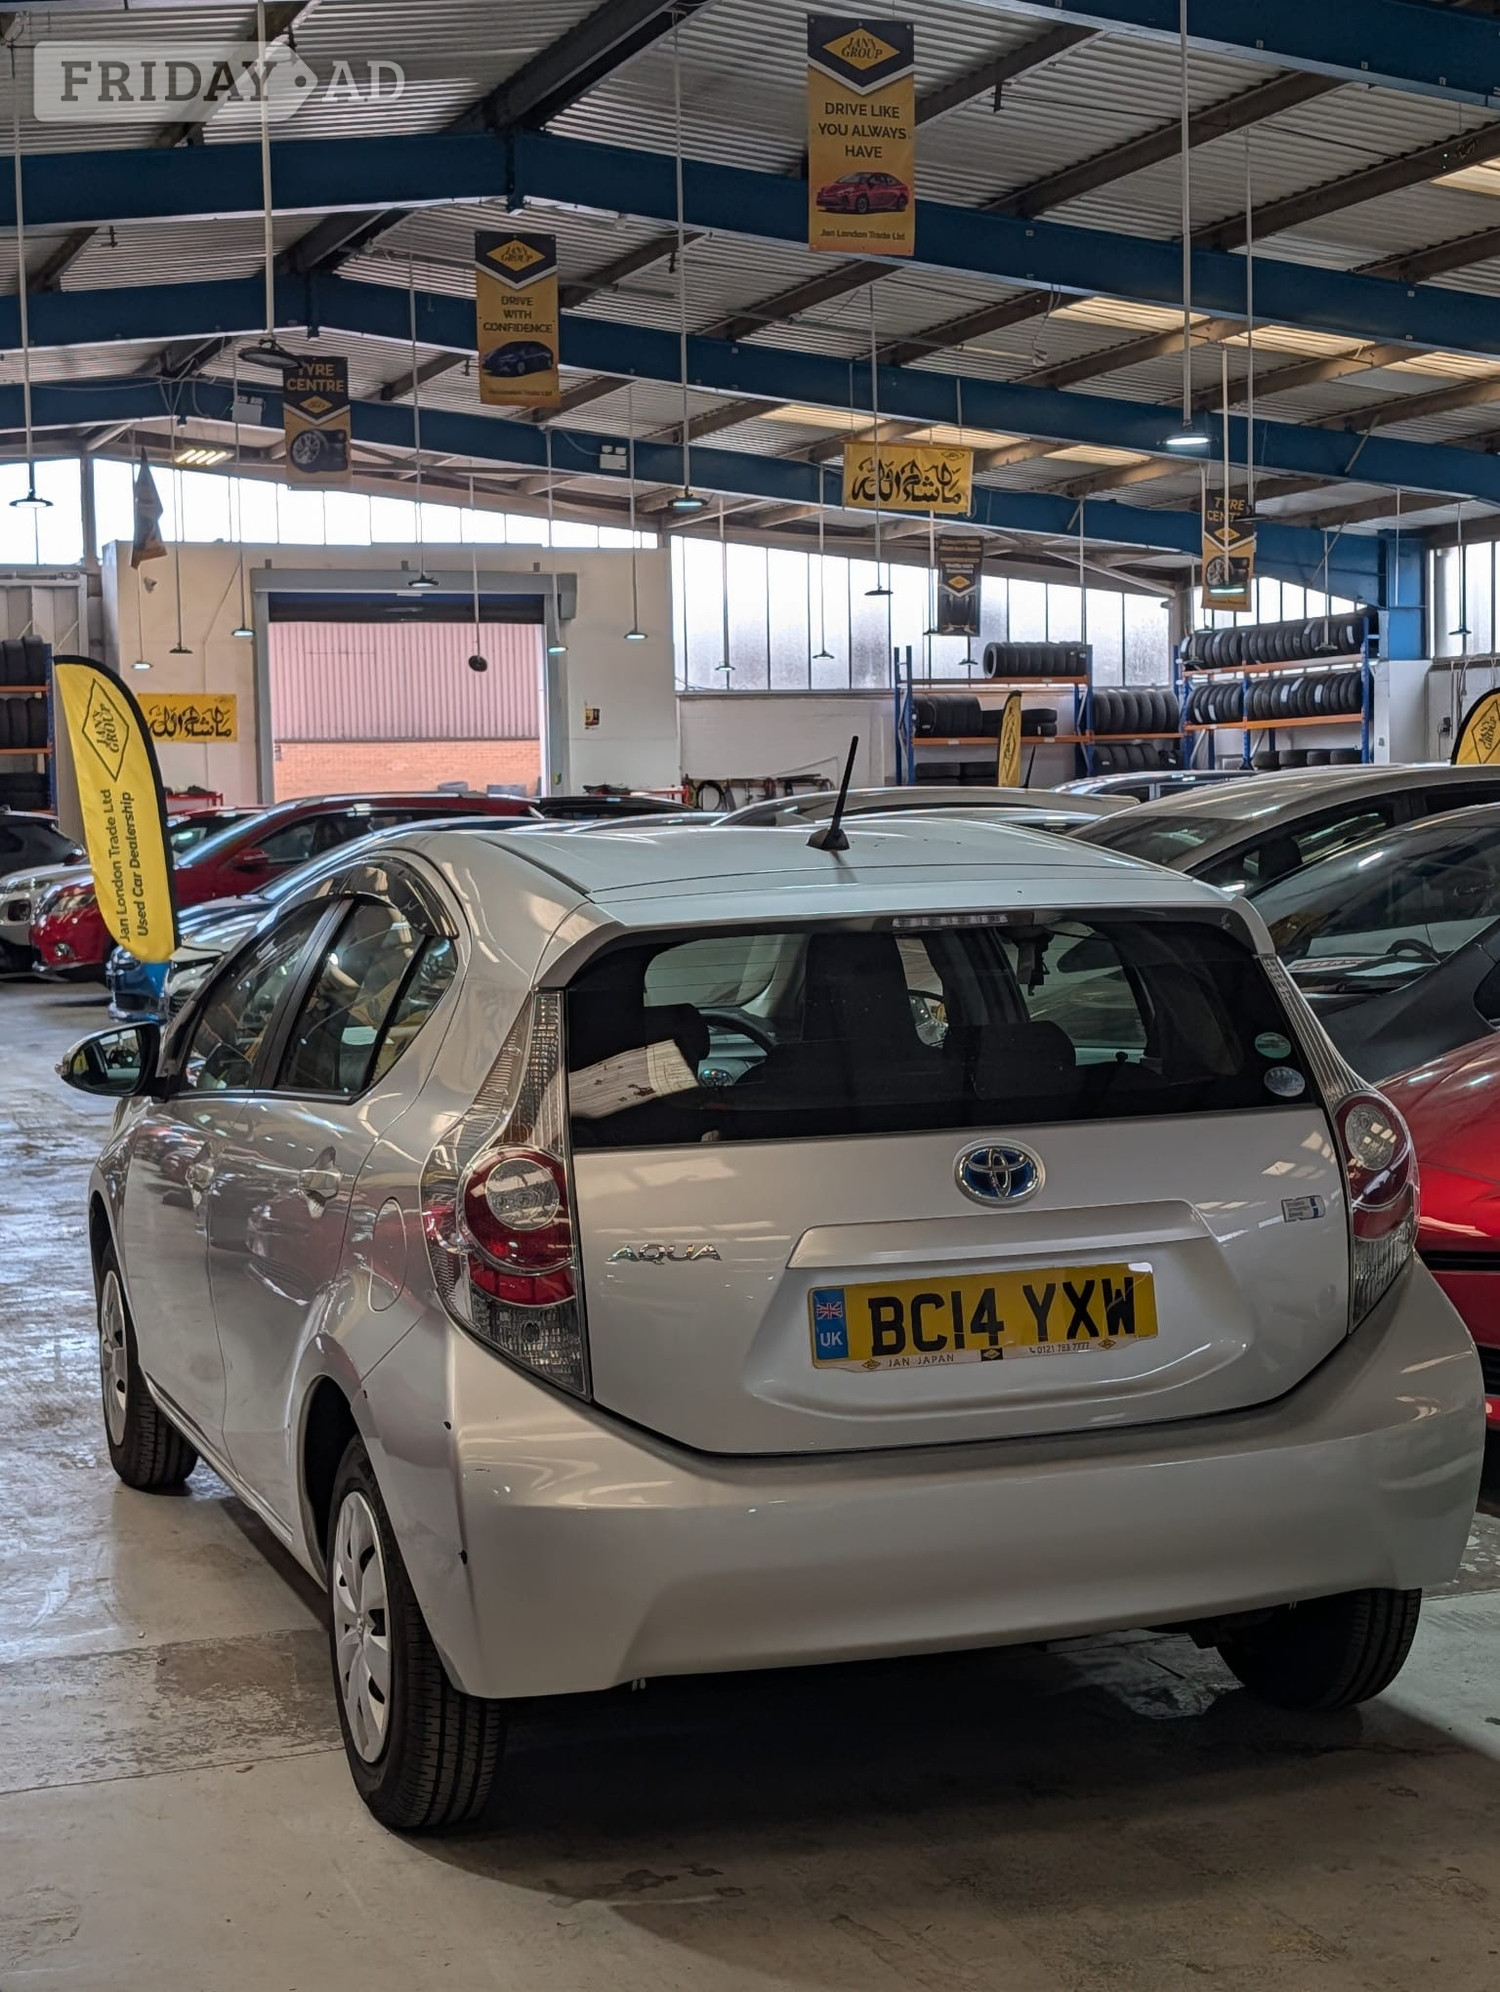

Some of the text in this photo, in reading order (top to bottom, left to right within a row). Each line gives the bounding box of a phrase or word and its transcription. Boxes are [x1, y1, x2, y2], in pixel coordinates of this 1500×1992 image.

[841, 46, 883, 60] GROUP
[825, 102, 900, 119] DRIVE LIKE
[818, 123, 907, 139] YOU ALWAYS
[845, 145, 883, 158] HAVE
[501, 296, 533, 306] DRIVE
[503, 310, 532, 319] WITH
[483, 322, 553, 334] CONFIDENCE
[286, 378, 345, 392] CENTRE
[1214, 497, 1246, 510] TRE
[99, 702, 119, 753] GROUP
[100, 788, 131, 942] Jan London Trade Ltd
[121, 792, 149, 936] Used Car Dealership
[606, 1244, 722, 1265] AQUA
[868, 1276, 1136, 1357] BC14 YXW
[820, 1332, 844, 1348] UK
[1037, 1345, 1055, 1354] 0121
[889, 1357, 910, 1367] JAN
[918, 1353, 954, 1365] JAPAN
